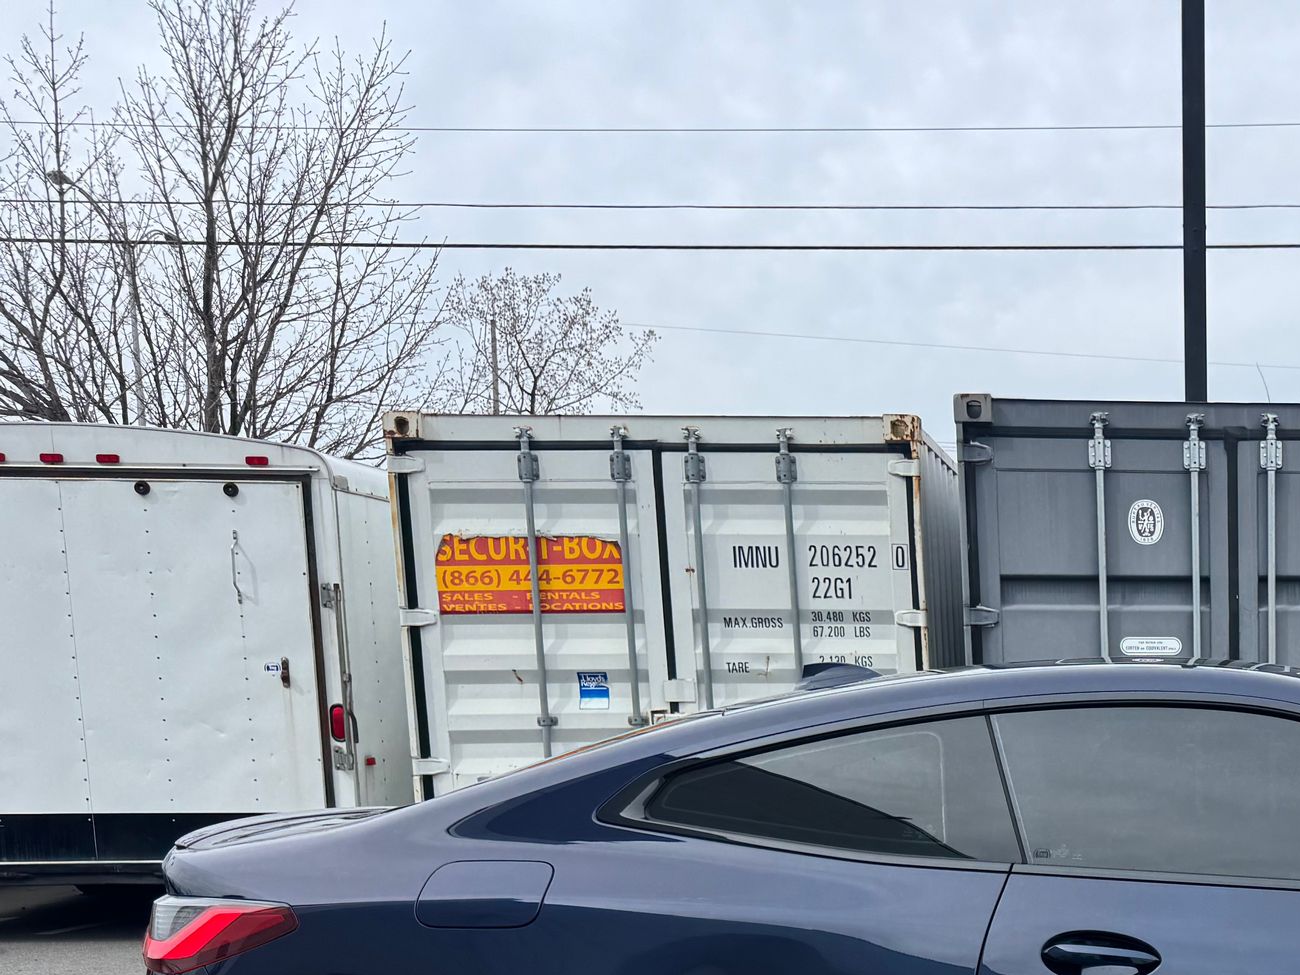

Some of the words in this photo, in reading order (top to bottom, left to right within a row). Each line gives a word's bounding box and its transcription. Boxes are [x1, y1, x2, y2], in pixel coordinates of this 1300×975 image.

[437, 534, 620, 560] SECURI-BOX
[732, 545, 780, 569] IMNU
[808, 545, 878, 568] 206252
[895, 545, 906, 568] 0
[442, 569, 501, 588] (866)
[442, 592, 494, 601] SALES
[811, 577, 853, 600] 22G1
[442, 602, 507, 611] VENTES
[852, 611, 871, 622] KGS
[854, 626, 871, 638] LBS
[726, 661, 750, 674] TARE
[855, 655, 873, 667] KGS
